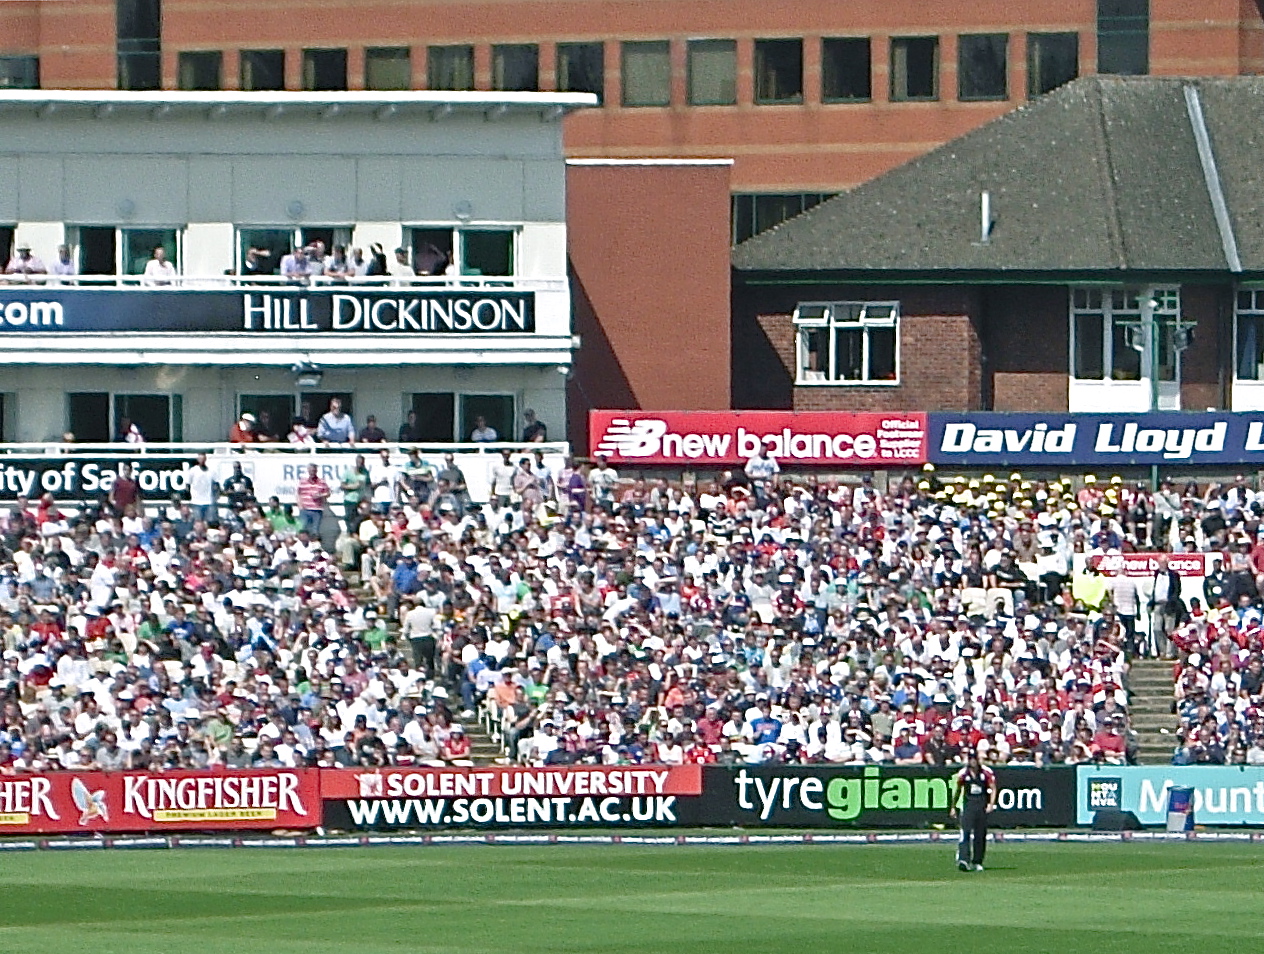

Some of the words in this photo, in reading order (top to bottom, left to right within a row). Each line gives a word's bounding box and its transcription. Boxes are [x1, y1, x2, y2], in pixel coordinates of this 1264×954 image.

[0, 302, 63, 325] om
[243, 294, 317, 329] HILL
[332, 294, 524, 330] DICKINSON
[663, 433, 731, 458] new
[737, 428, 876, 458] balance
[940, 423, 1076, 452] David
[1094, 421, 1227, 459] Lloyd
[41, 462, 75, 490] of
[1149, 558, 1200, 570] bance
[124, 772, 307, 818] KINGFISHER
[387, 773, 494, 797] SOLENT
[501, 770, 668, 796] UNIVERSITY
[347, 796, 676, 824] WWW.SOLENT.AC.UK
